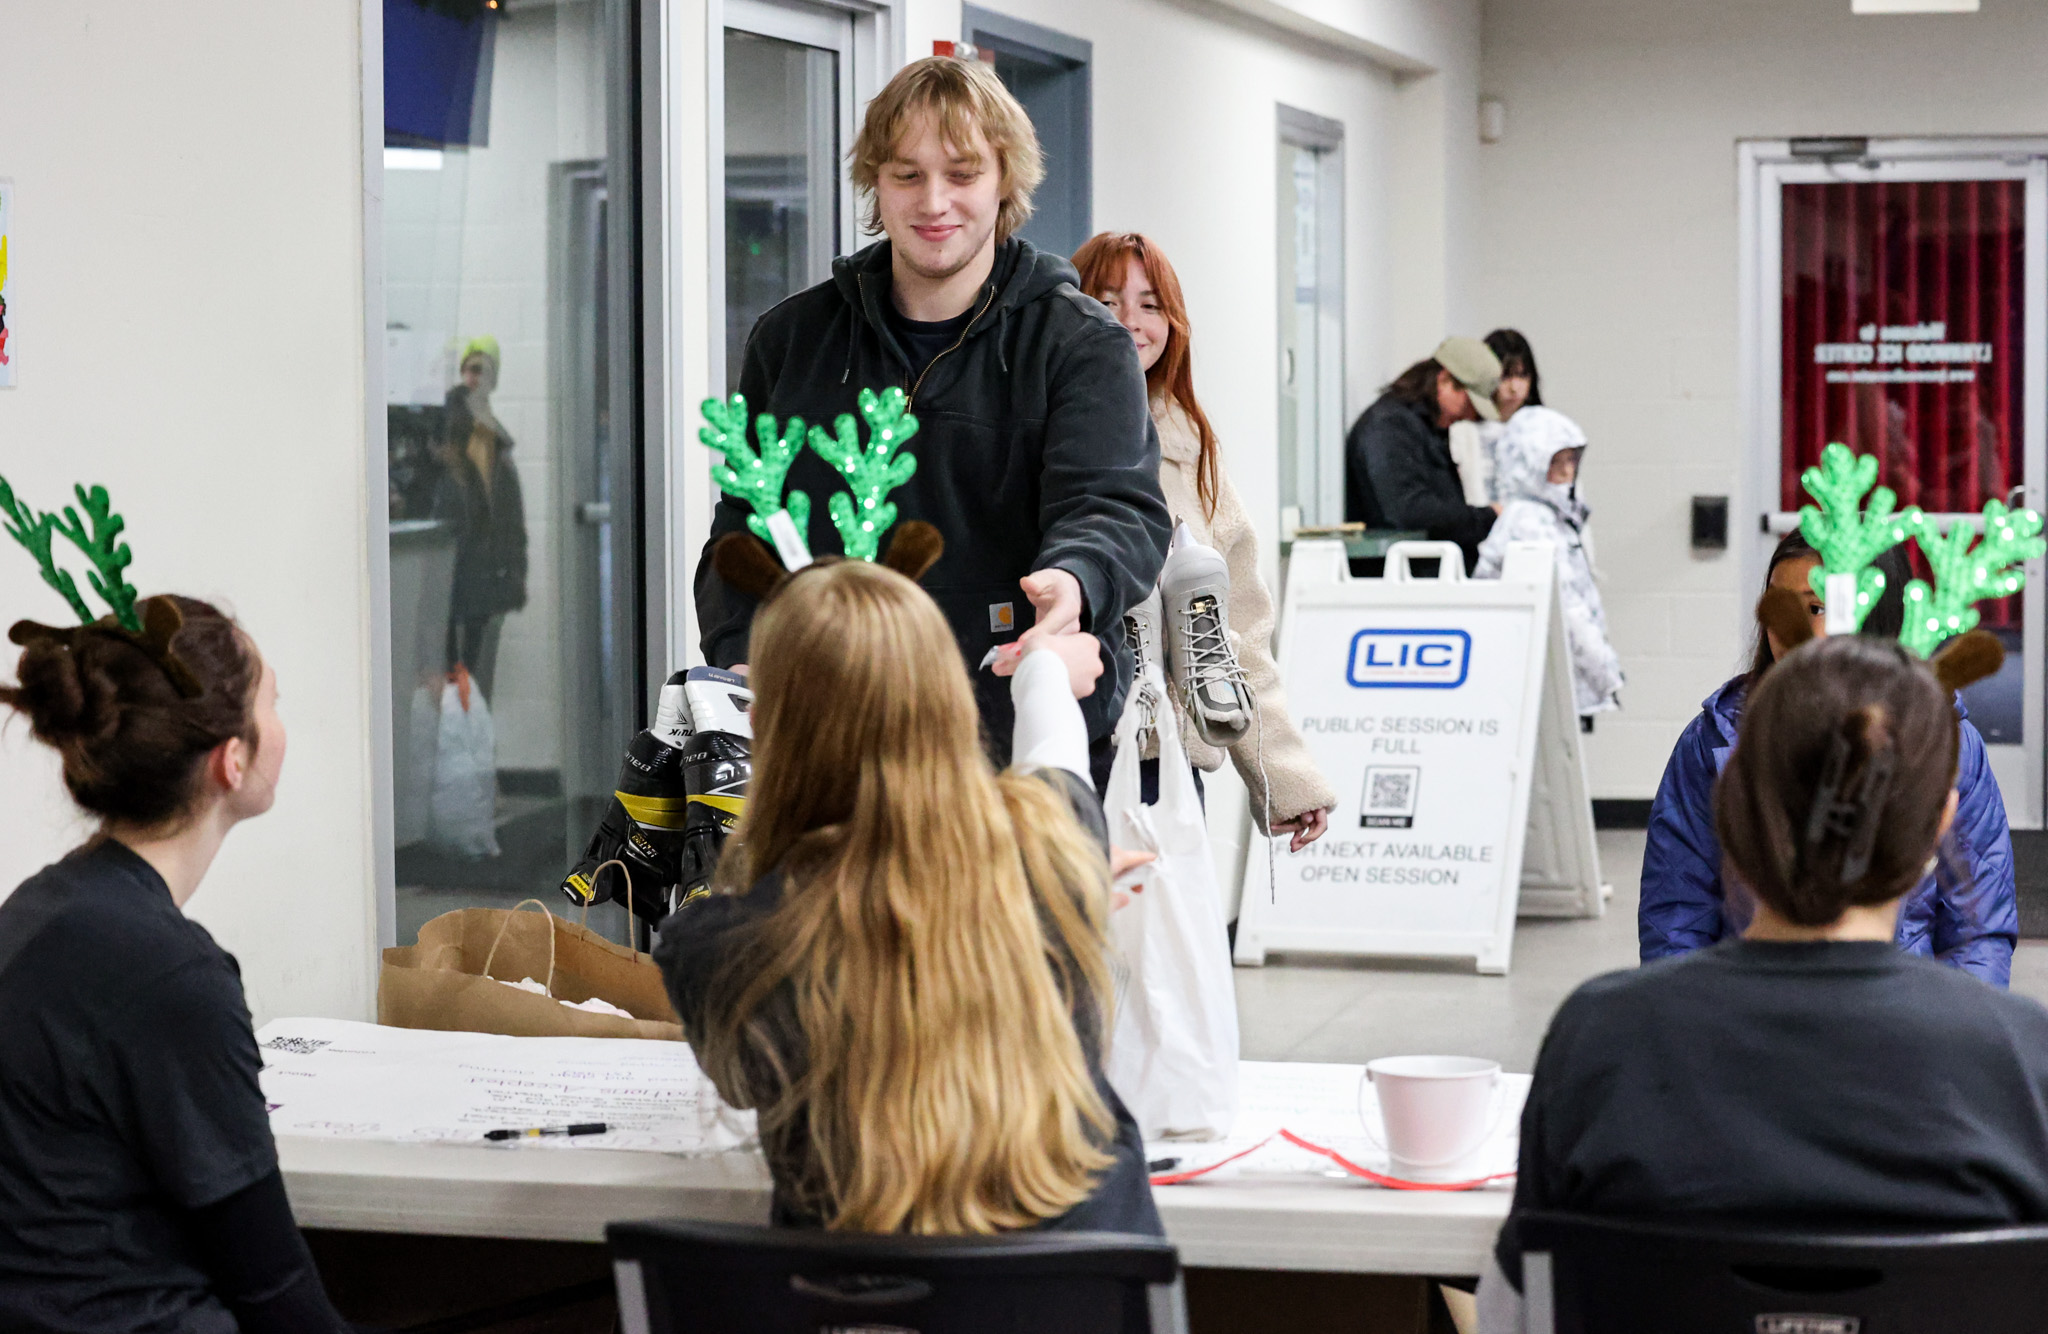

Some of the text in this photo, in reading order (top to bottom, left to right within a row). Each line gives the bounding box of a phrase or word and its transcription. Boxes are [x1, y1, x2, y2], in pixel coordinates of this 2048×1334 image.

[1366, 643, 1454, 667] LIC
[1302, 716, 1499, 735] PUBLIC SESSION IS
[1371, 737, 1421, 754] FULL
[1323, 842, 1377, 859] NEXT
[1382, 843, 1494, 863] AVAILABLE
[1300, 865, 1461, 885] OPEN SESSION
